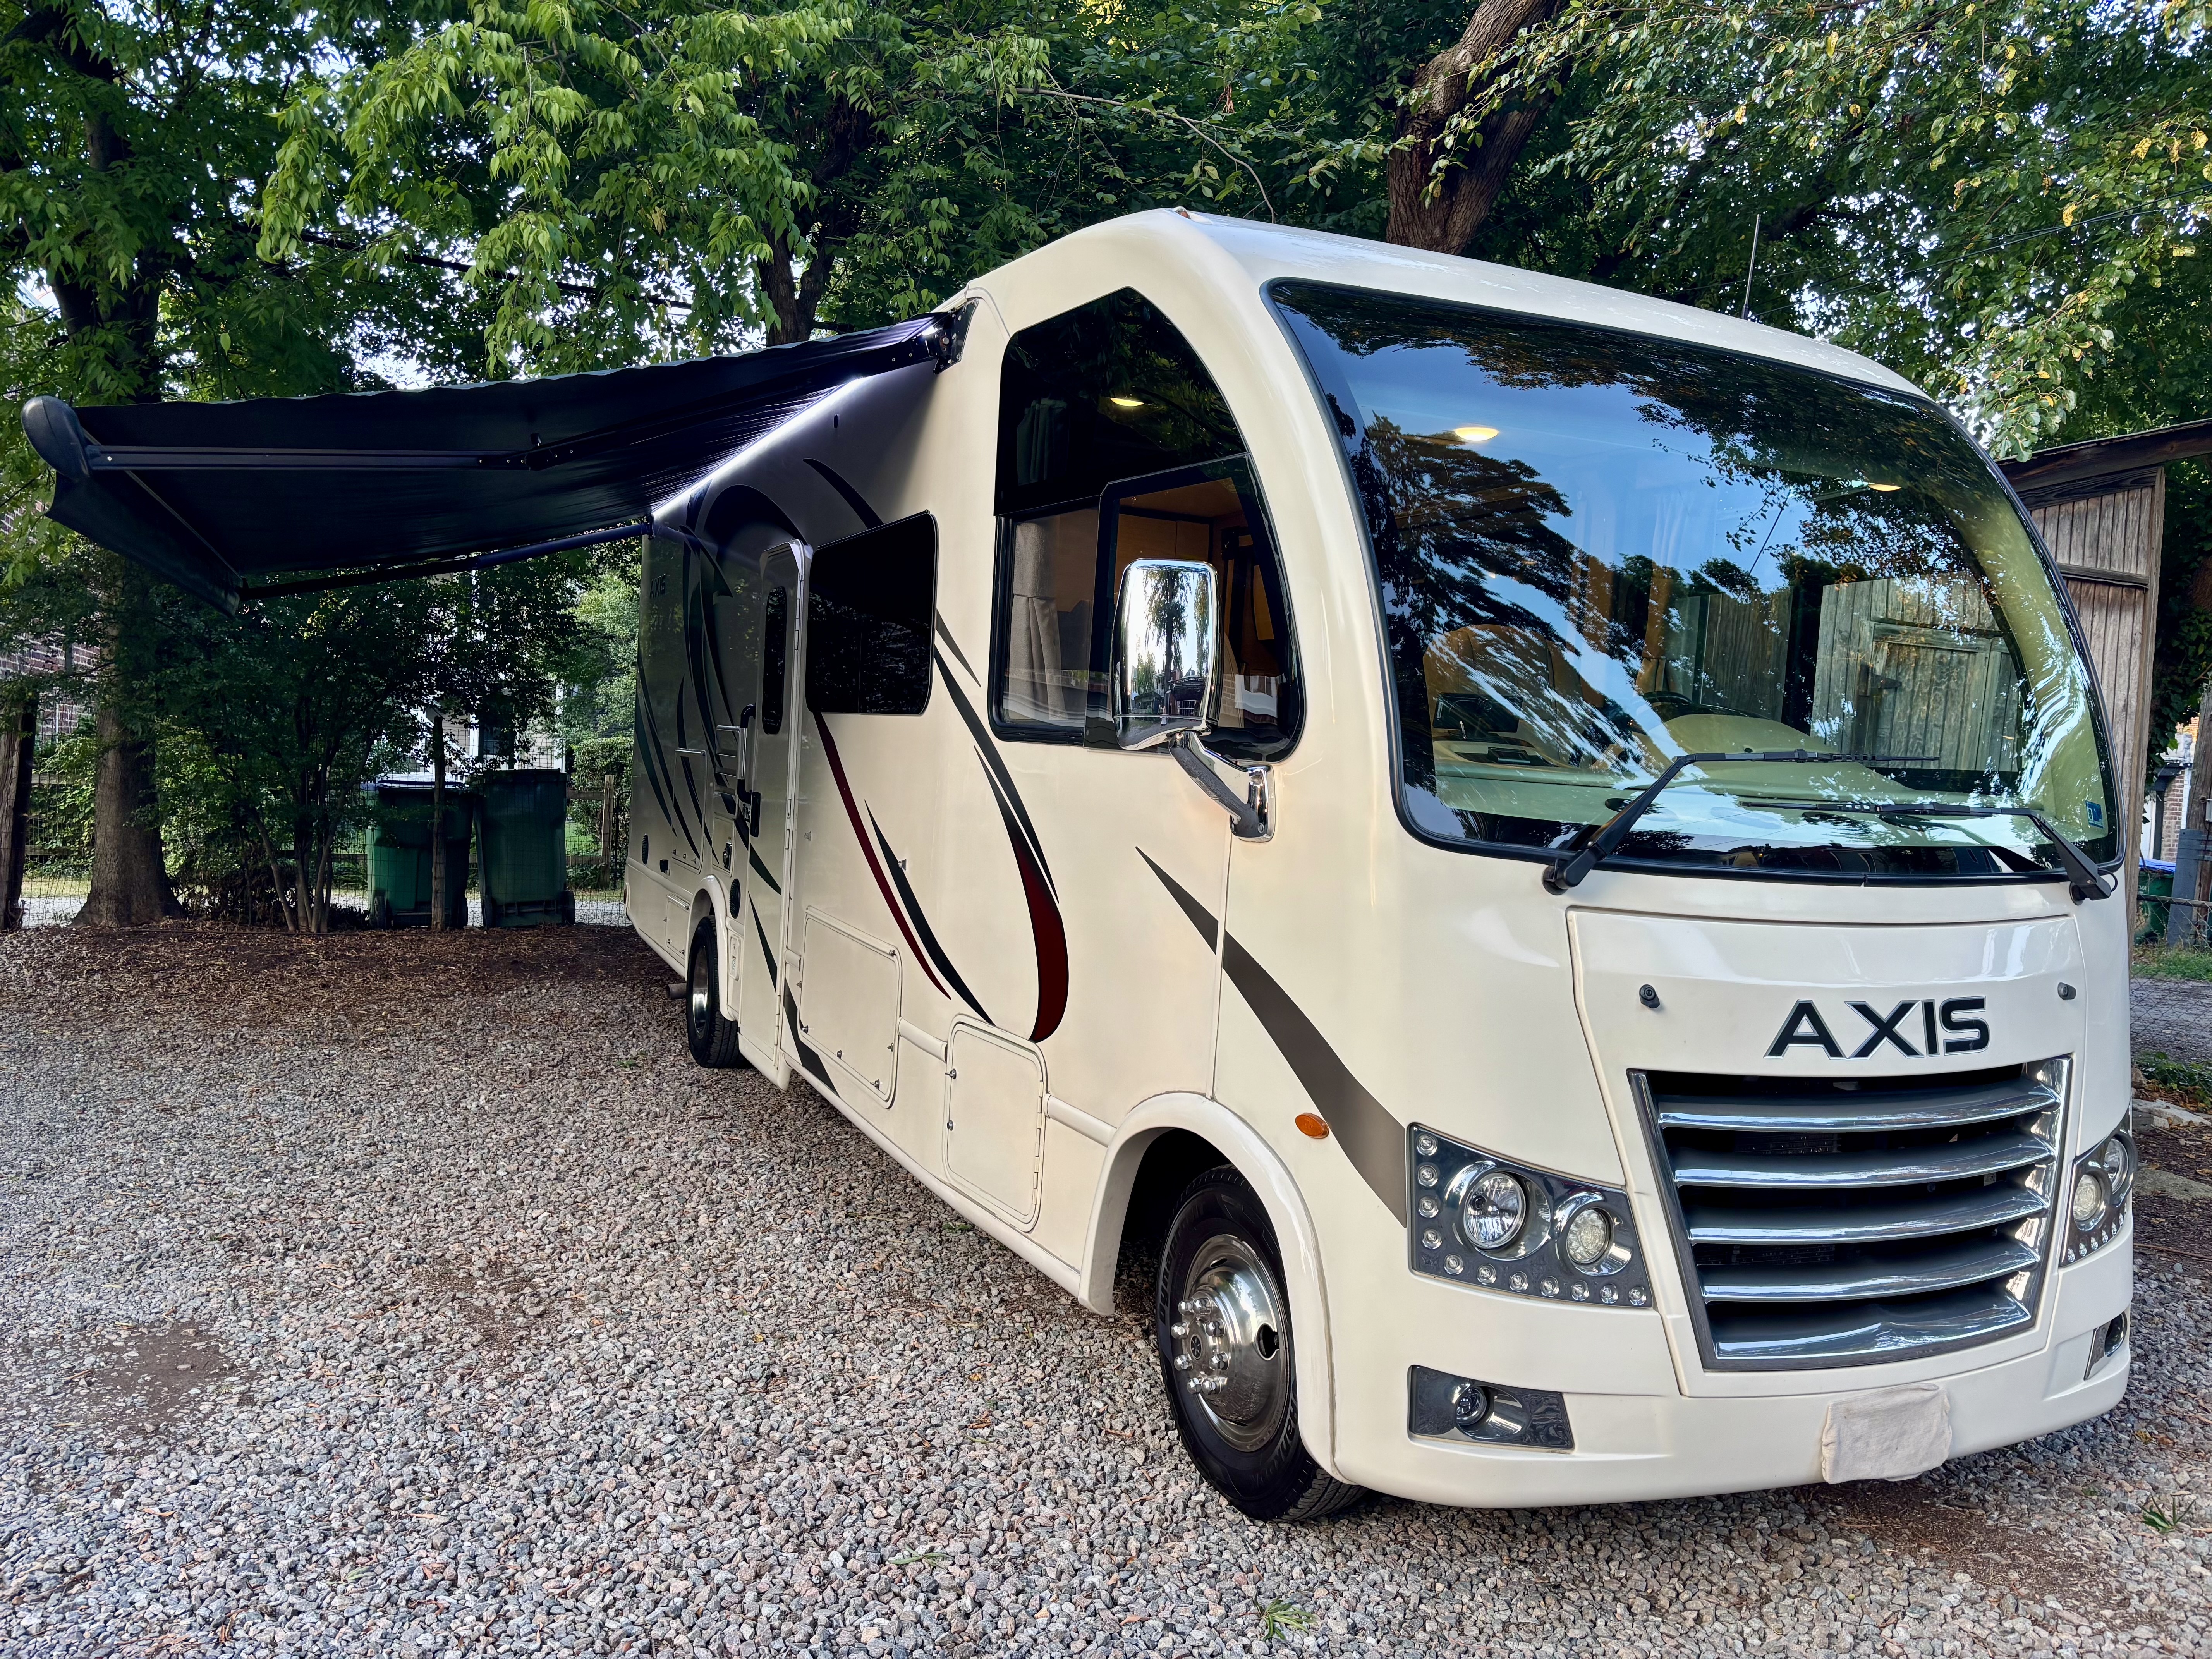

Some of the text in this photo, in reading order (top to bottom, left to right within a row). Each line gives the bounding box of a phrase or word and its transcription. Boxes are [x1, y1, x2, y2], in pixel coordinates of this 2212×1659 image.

[649, 573, 666, 599] AXIS
[2088, 809, 2092, 819] 8
[1763, 996, 1990, 1060] AXIS
